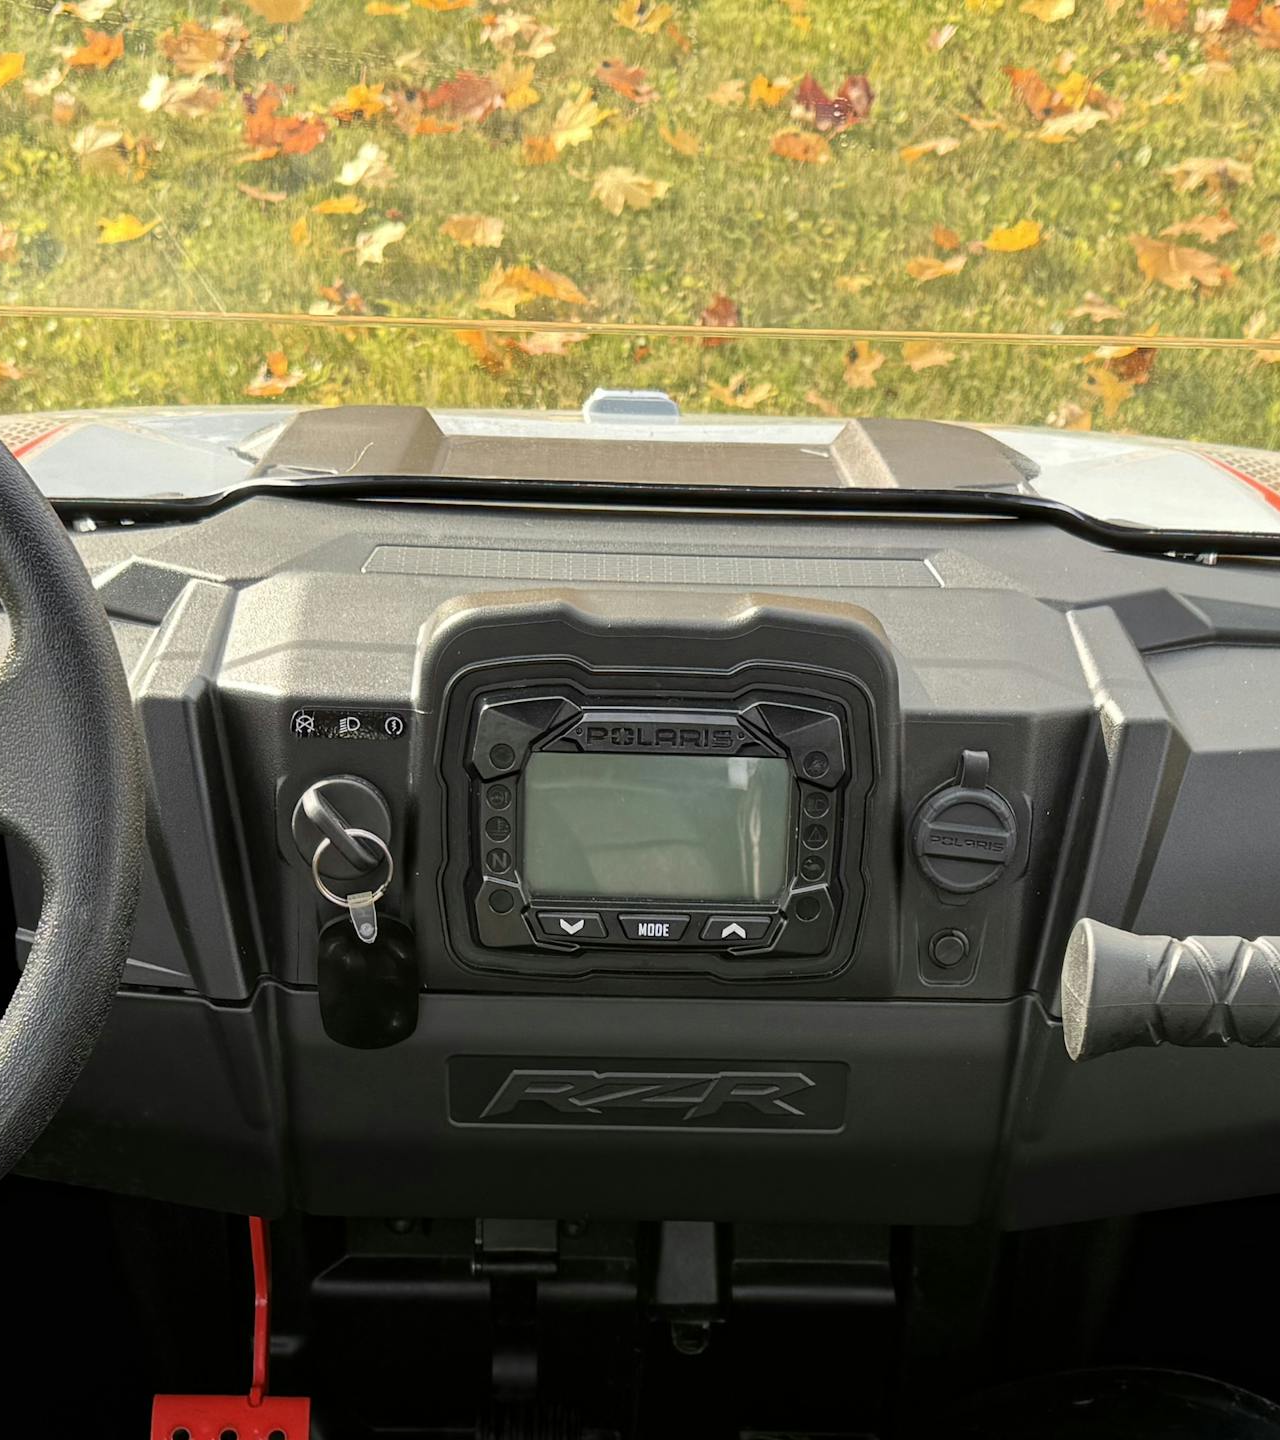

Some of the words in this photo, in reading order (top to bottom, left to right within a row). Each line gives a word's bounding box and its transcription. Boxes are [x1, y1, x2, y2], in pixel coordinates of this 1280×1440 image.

[586, 727, 734, 749] POLARIS
[929, 835, 1005, 852] POLARIS
[491, 853, 508, 869] N
[638, 923, 670, 937] MODE
[479, 1069, 816, 1120] RZR
